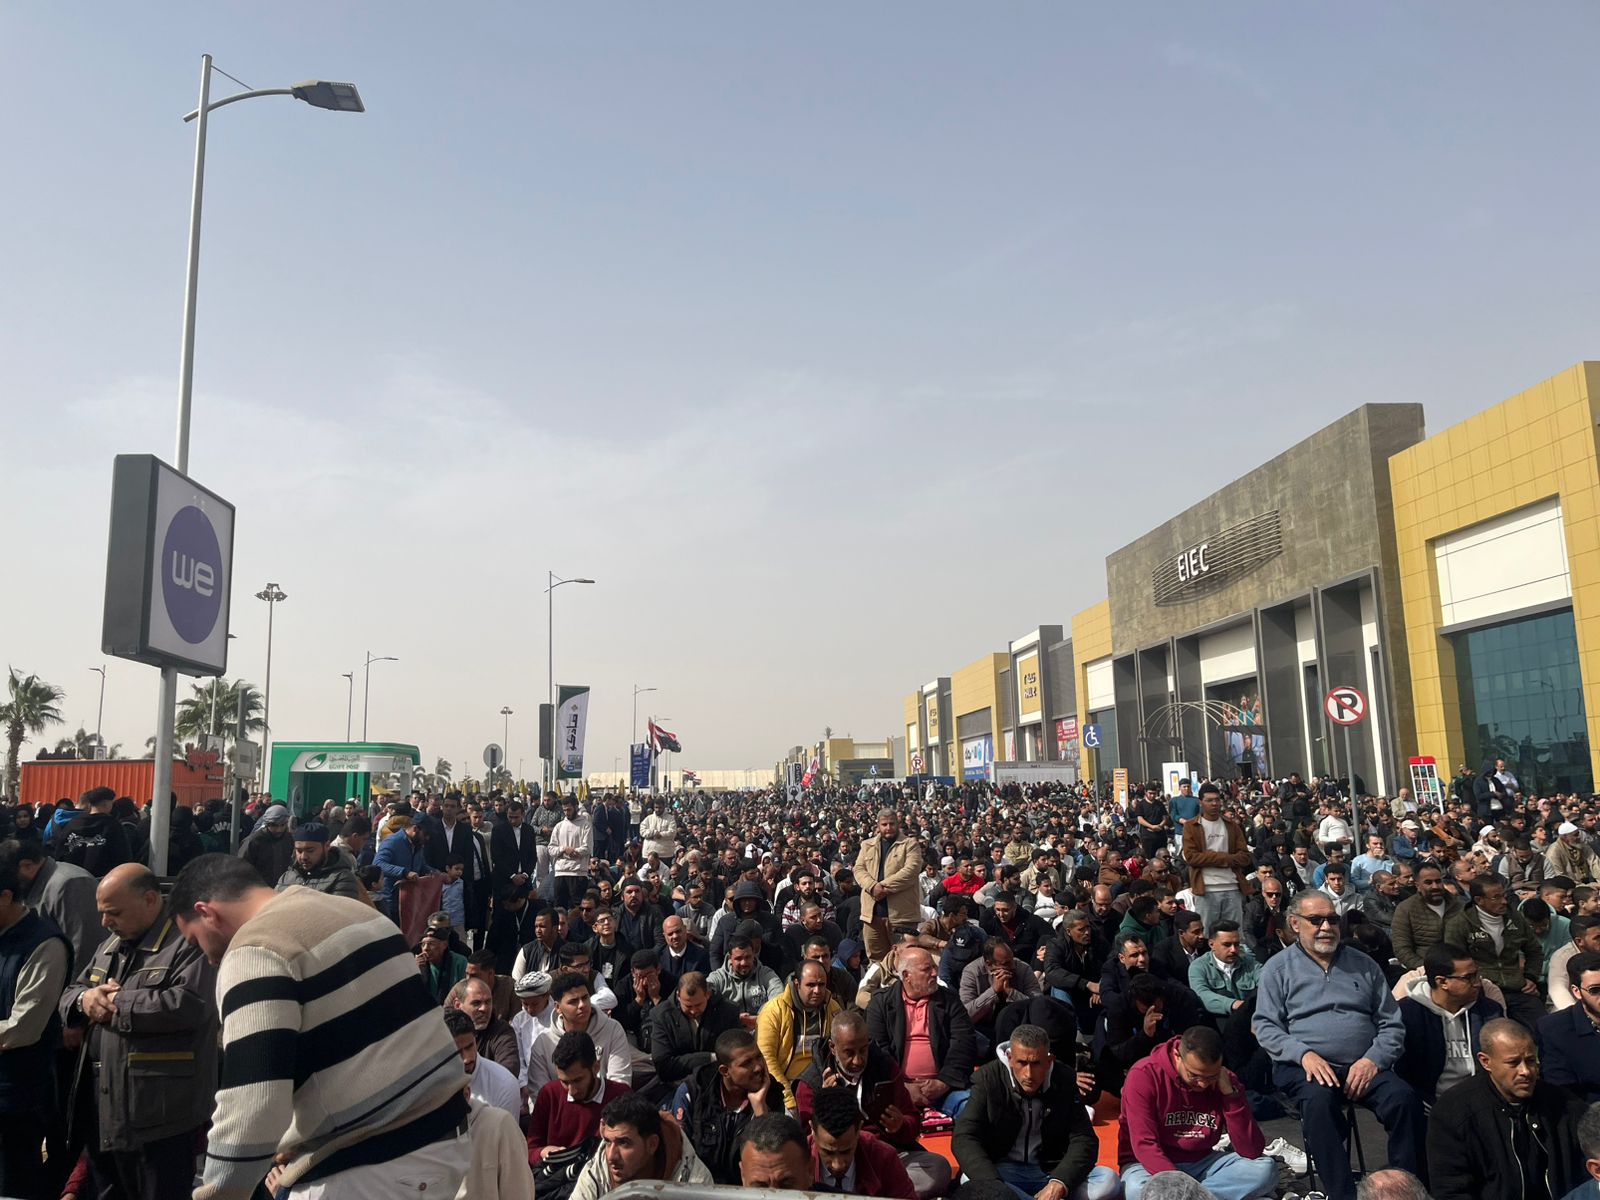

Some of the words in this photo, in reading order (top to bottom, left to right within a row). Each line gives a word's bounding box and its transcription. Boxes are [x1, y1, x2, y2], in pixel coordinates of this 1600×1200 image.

[171, 550, 214, 597] we
[1177, 544, 1210, 582] EIEC
[1164, 1110, 1218, 1130] REBACK
